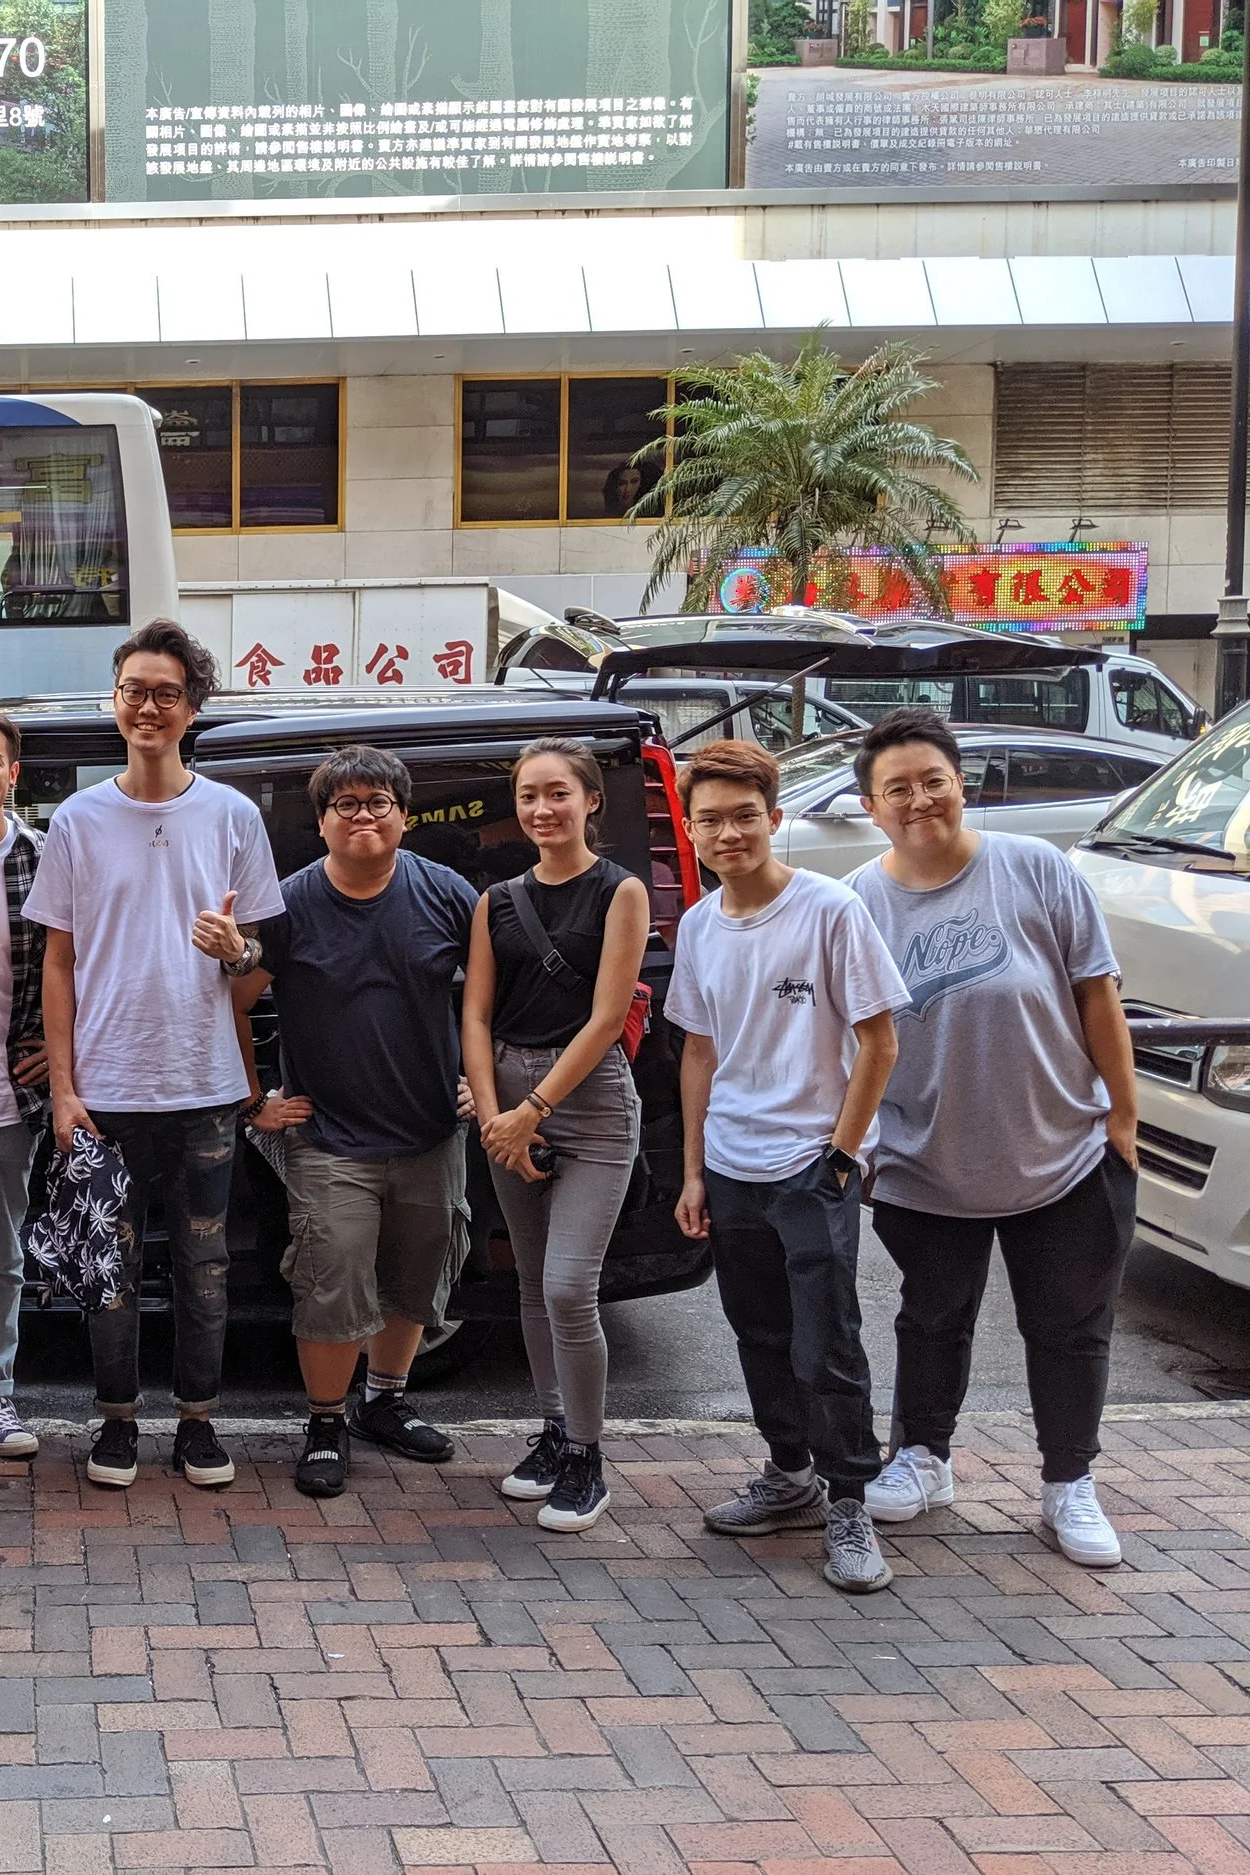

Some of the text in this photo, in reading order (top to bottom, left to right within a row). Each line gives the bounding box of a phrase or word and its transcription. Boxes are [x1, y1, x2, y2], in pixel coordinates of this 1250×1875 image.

[234, 641, 474, 688] 食品公司
[900, 908, 997, 973] Nope
[307, 1450, 339, 1462] PUMA
